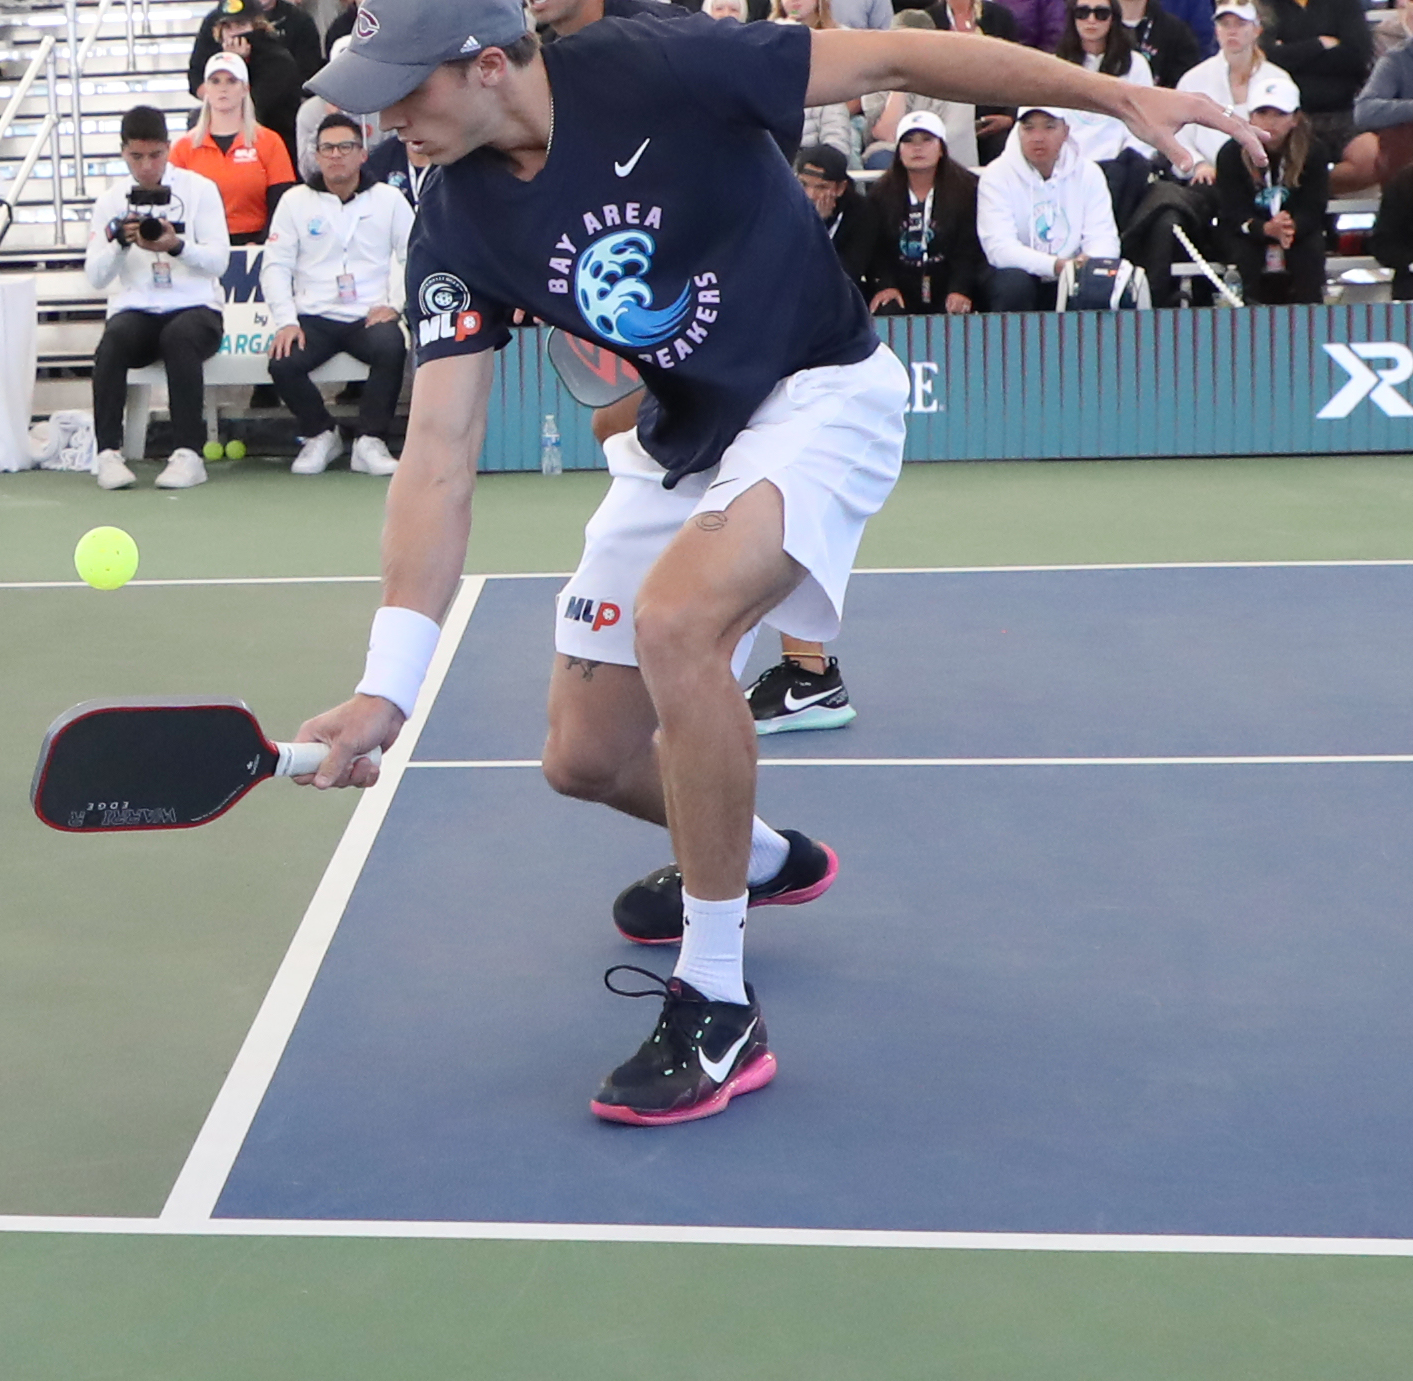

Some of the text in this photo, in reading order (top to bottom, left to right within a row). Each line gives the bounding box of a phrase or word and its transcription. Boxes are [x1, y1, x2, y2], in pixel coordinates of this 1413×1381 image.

[548, 202, 662, 294] BAY AREA
[254, 312, 268, 326] by
[419, 310, 482, 347] MLP
[564, 596, 621, 632] MLP
[86, 801, 130, 811] EDGE
